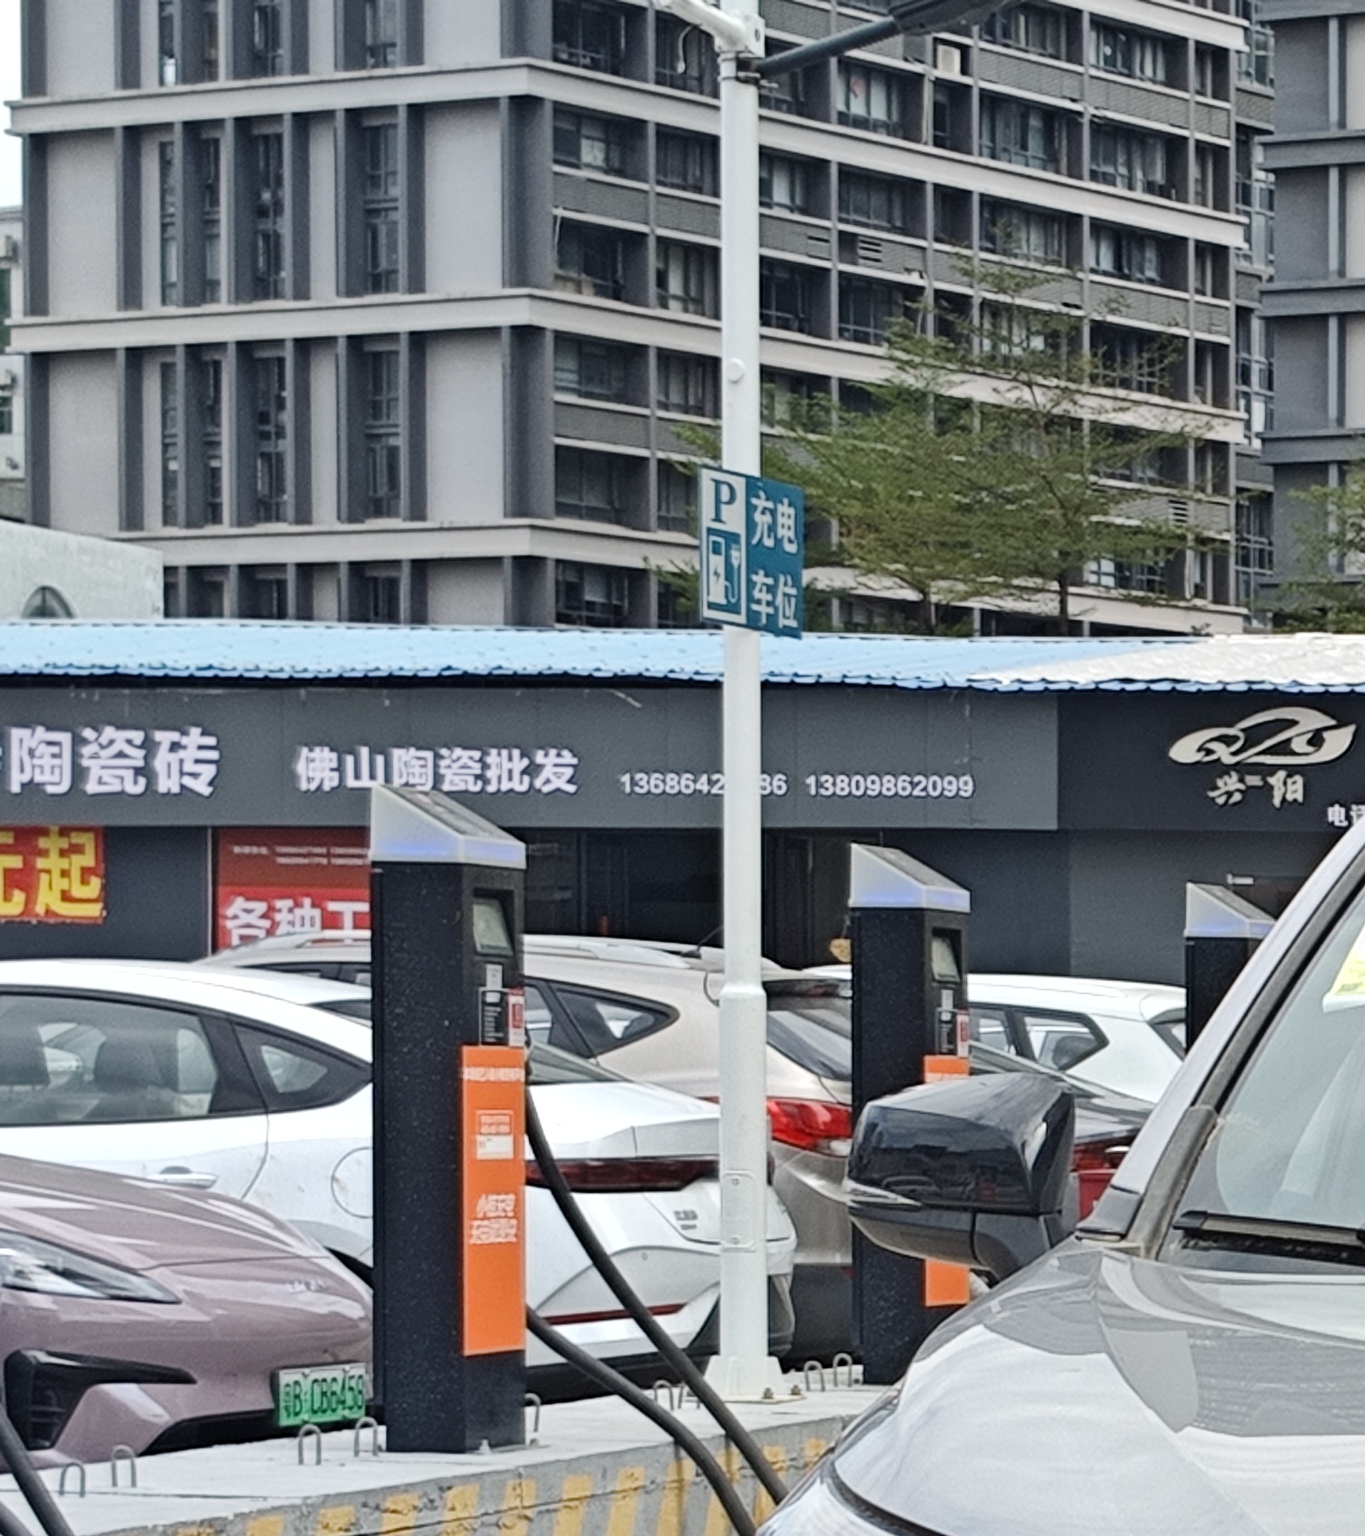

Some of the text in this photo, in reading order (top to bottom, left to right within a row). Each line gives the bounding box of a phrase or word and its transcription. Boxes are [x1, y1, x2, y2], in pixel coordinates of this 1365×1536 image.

[710, 478, 738, 525] P
[750, 490, 799, 554] 充电
[750, 569, 799, 629] 车位
[9, 725, 220, 797] 陶瓷砖
[295, 745, 579, 794] 佛山陶瓷批发
[619, 772, 975, 798] 136864286 13809862099
